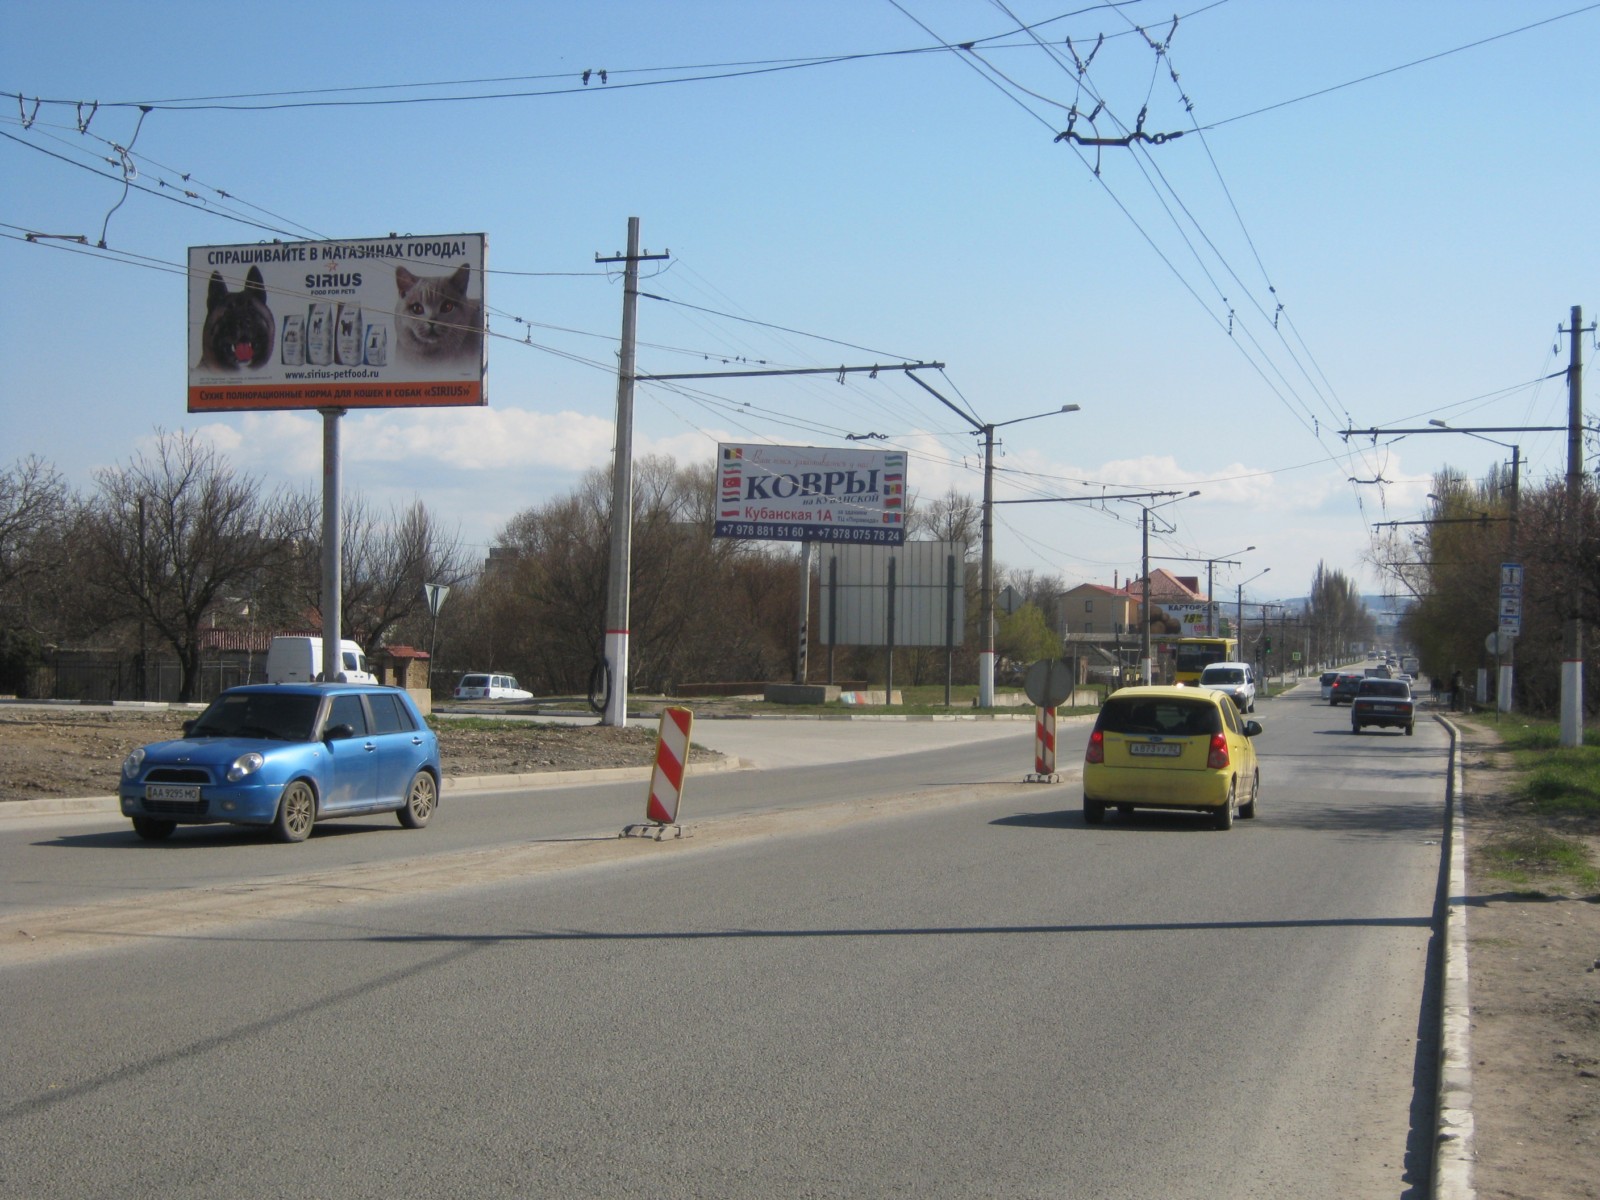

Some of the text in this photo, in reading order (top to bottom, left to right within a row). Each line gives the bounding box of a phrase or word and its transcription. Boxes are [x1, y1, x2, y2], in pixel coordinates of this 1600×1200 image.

[208, 241, 466, 265] СПРАШИВАЙТЕ В МАГАЗИНАХ ГОРОДА!
[305, 272, 362, 288] SIRIUS
[285, 368, 379, 380] www.sirius-petfood.ru
[424, 386, 470, 397] «SIRIUS»
[744, 469, 881, 500] КОВРЫ
[815, 494, 879, 505] КУБАНСКОЙ
[745, 506, 832, 521] Кубанская 1А
[722, 524, 899, 541] +7 978 881 51 60 +7 978 075 78 24
[152, 788, 164, 798] AA
